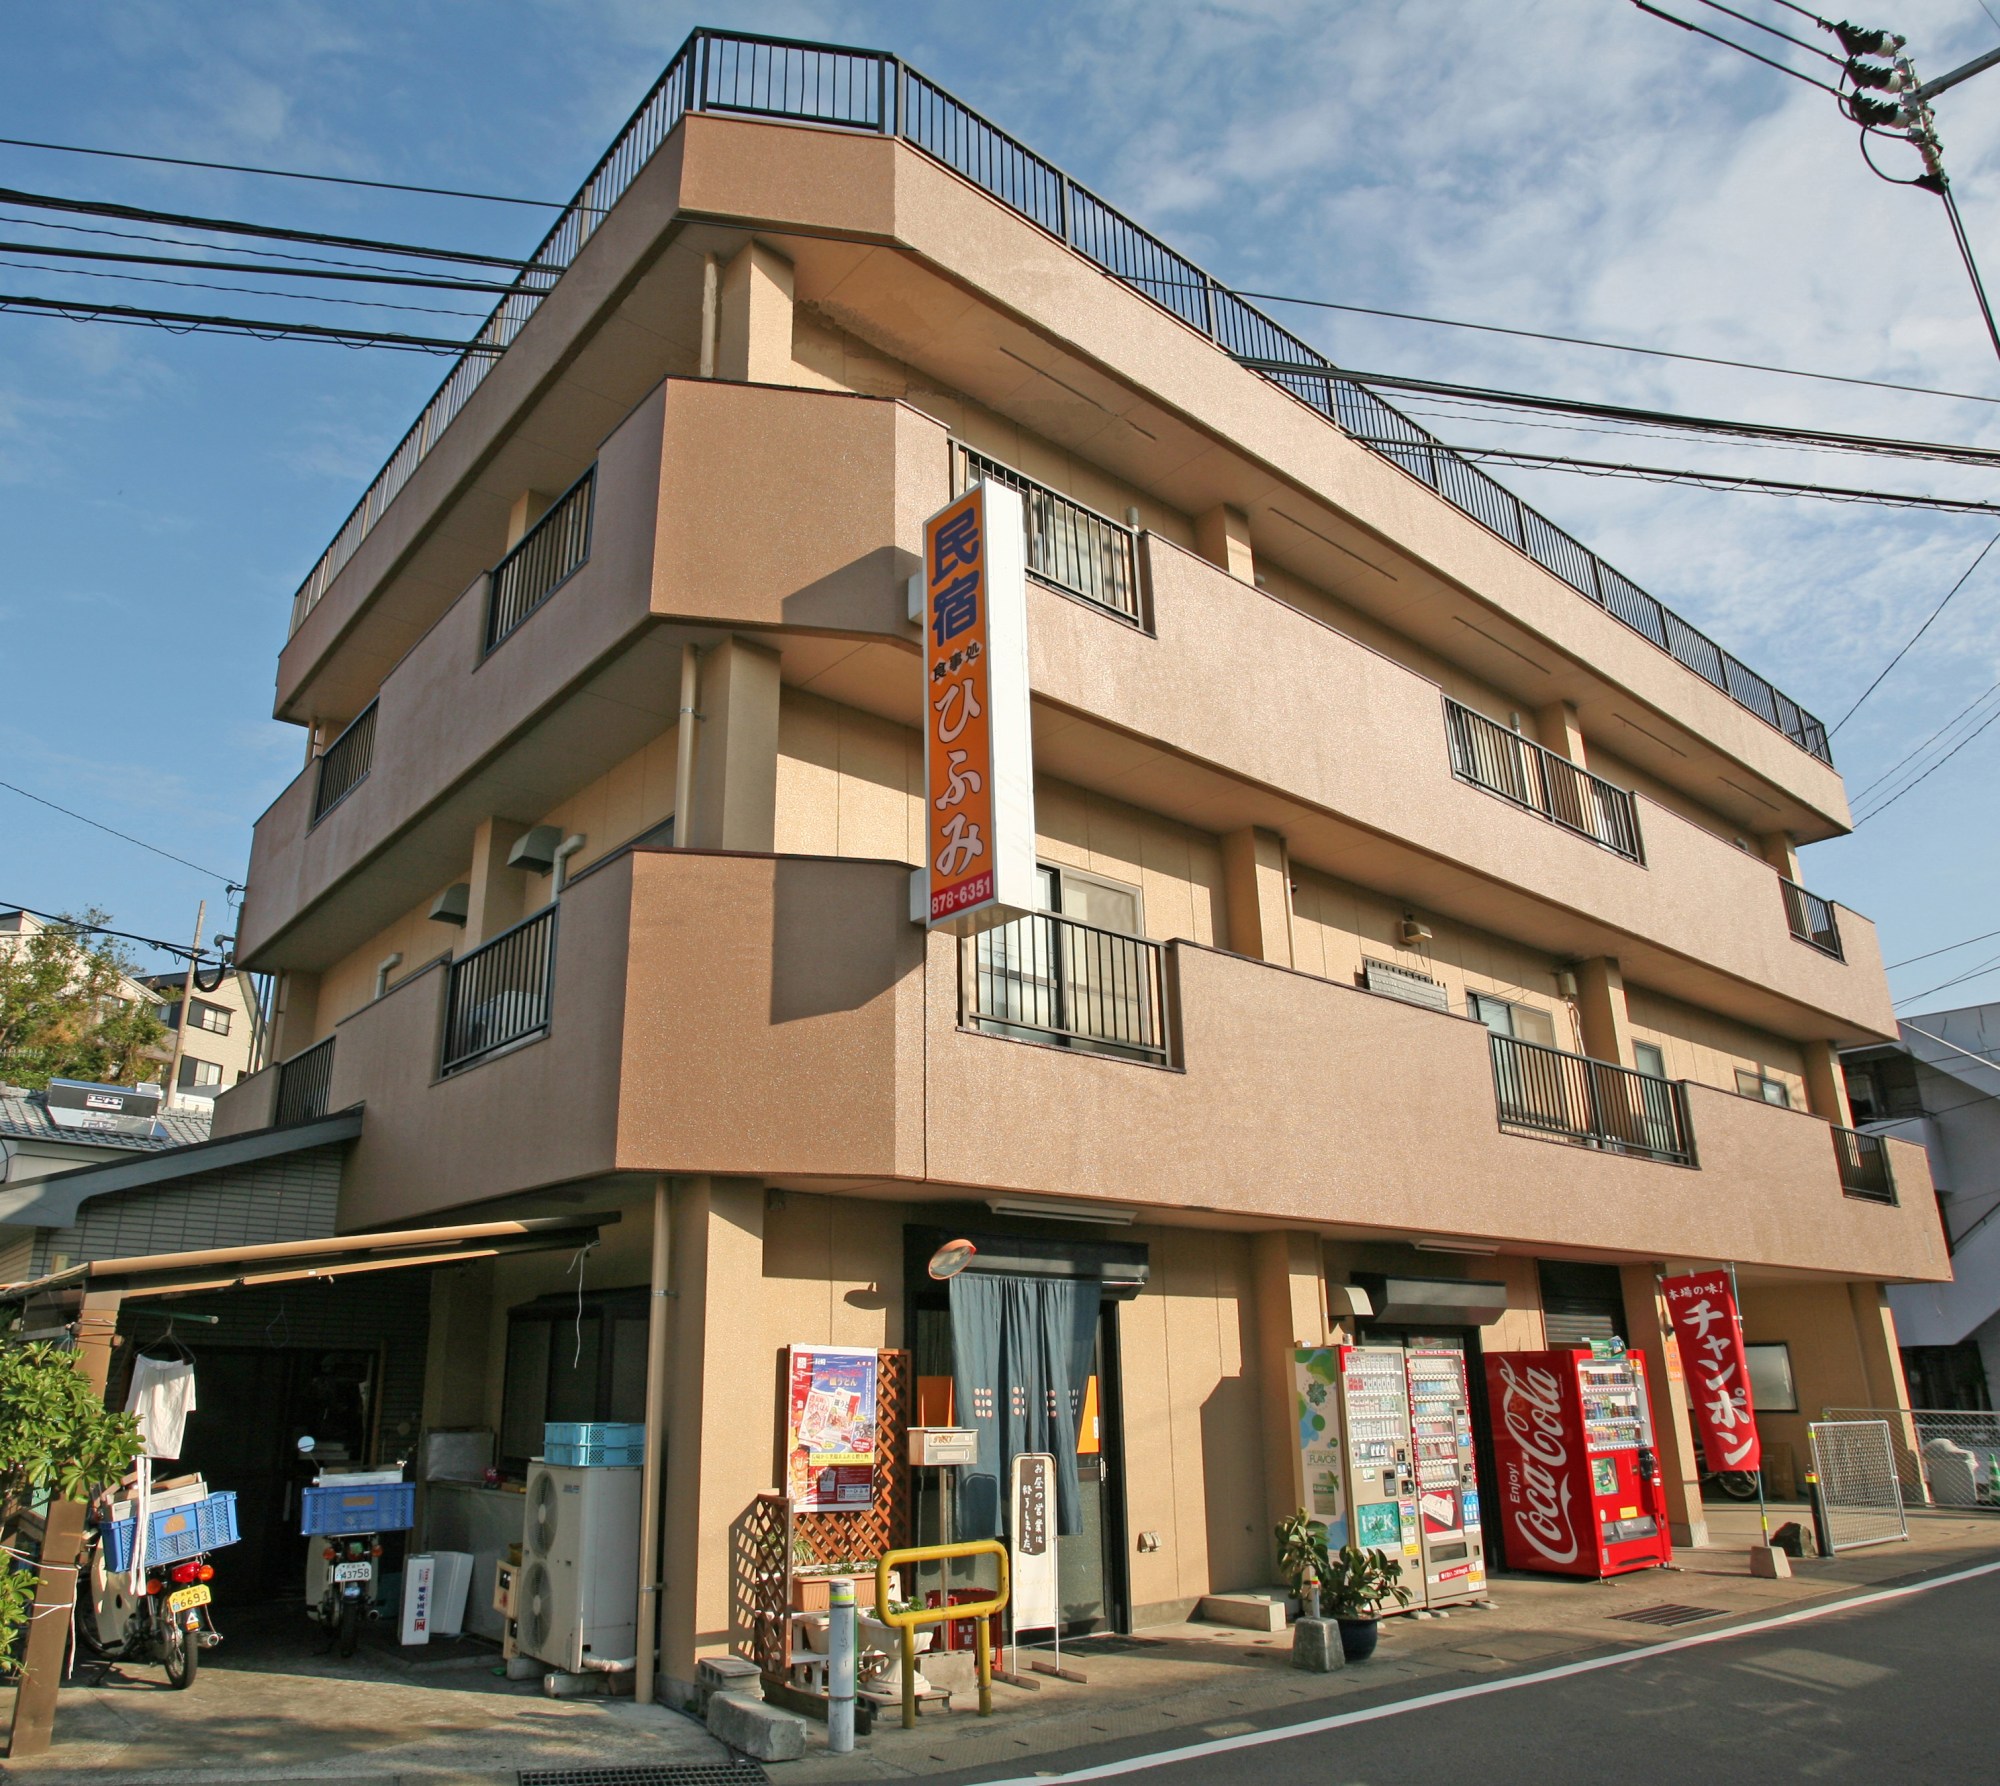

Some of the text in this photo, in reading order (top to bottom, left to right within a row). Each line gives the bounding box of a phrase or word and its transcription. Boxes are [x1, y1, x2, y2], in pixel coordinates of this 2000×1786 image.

[931, 506, 981, 648] 民宿
[932, 641, 981, 683] 食事処
[932, 677, 984, 877] ひふみ
[931, 876, 991, 915] 878-6351
[1682, 1299, 1754, 1466] チャンポン
[1309, 1454, 1337, 1464] FLAVOR
[1498, 1355, 1578, 1564] Coca-Cola
[1509, 1462, 1521, 1504] Enjoy!
[1034, 1463, 1044, 1544] お昼の営業は
[180, 1591, 208, 1608] 6693
